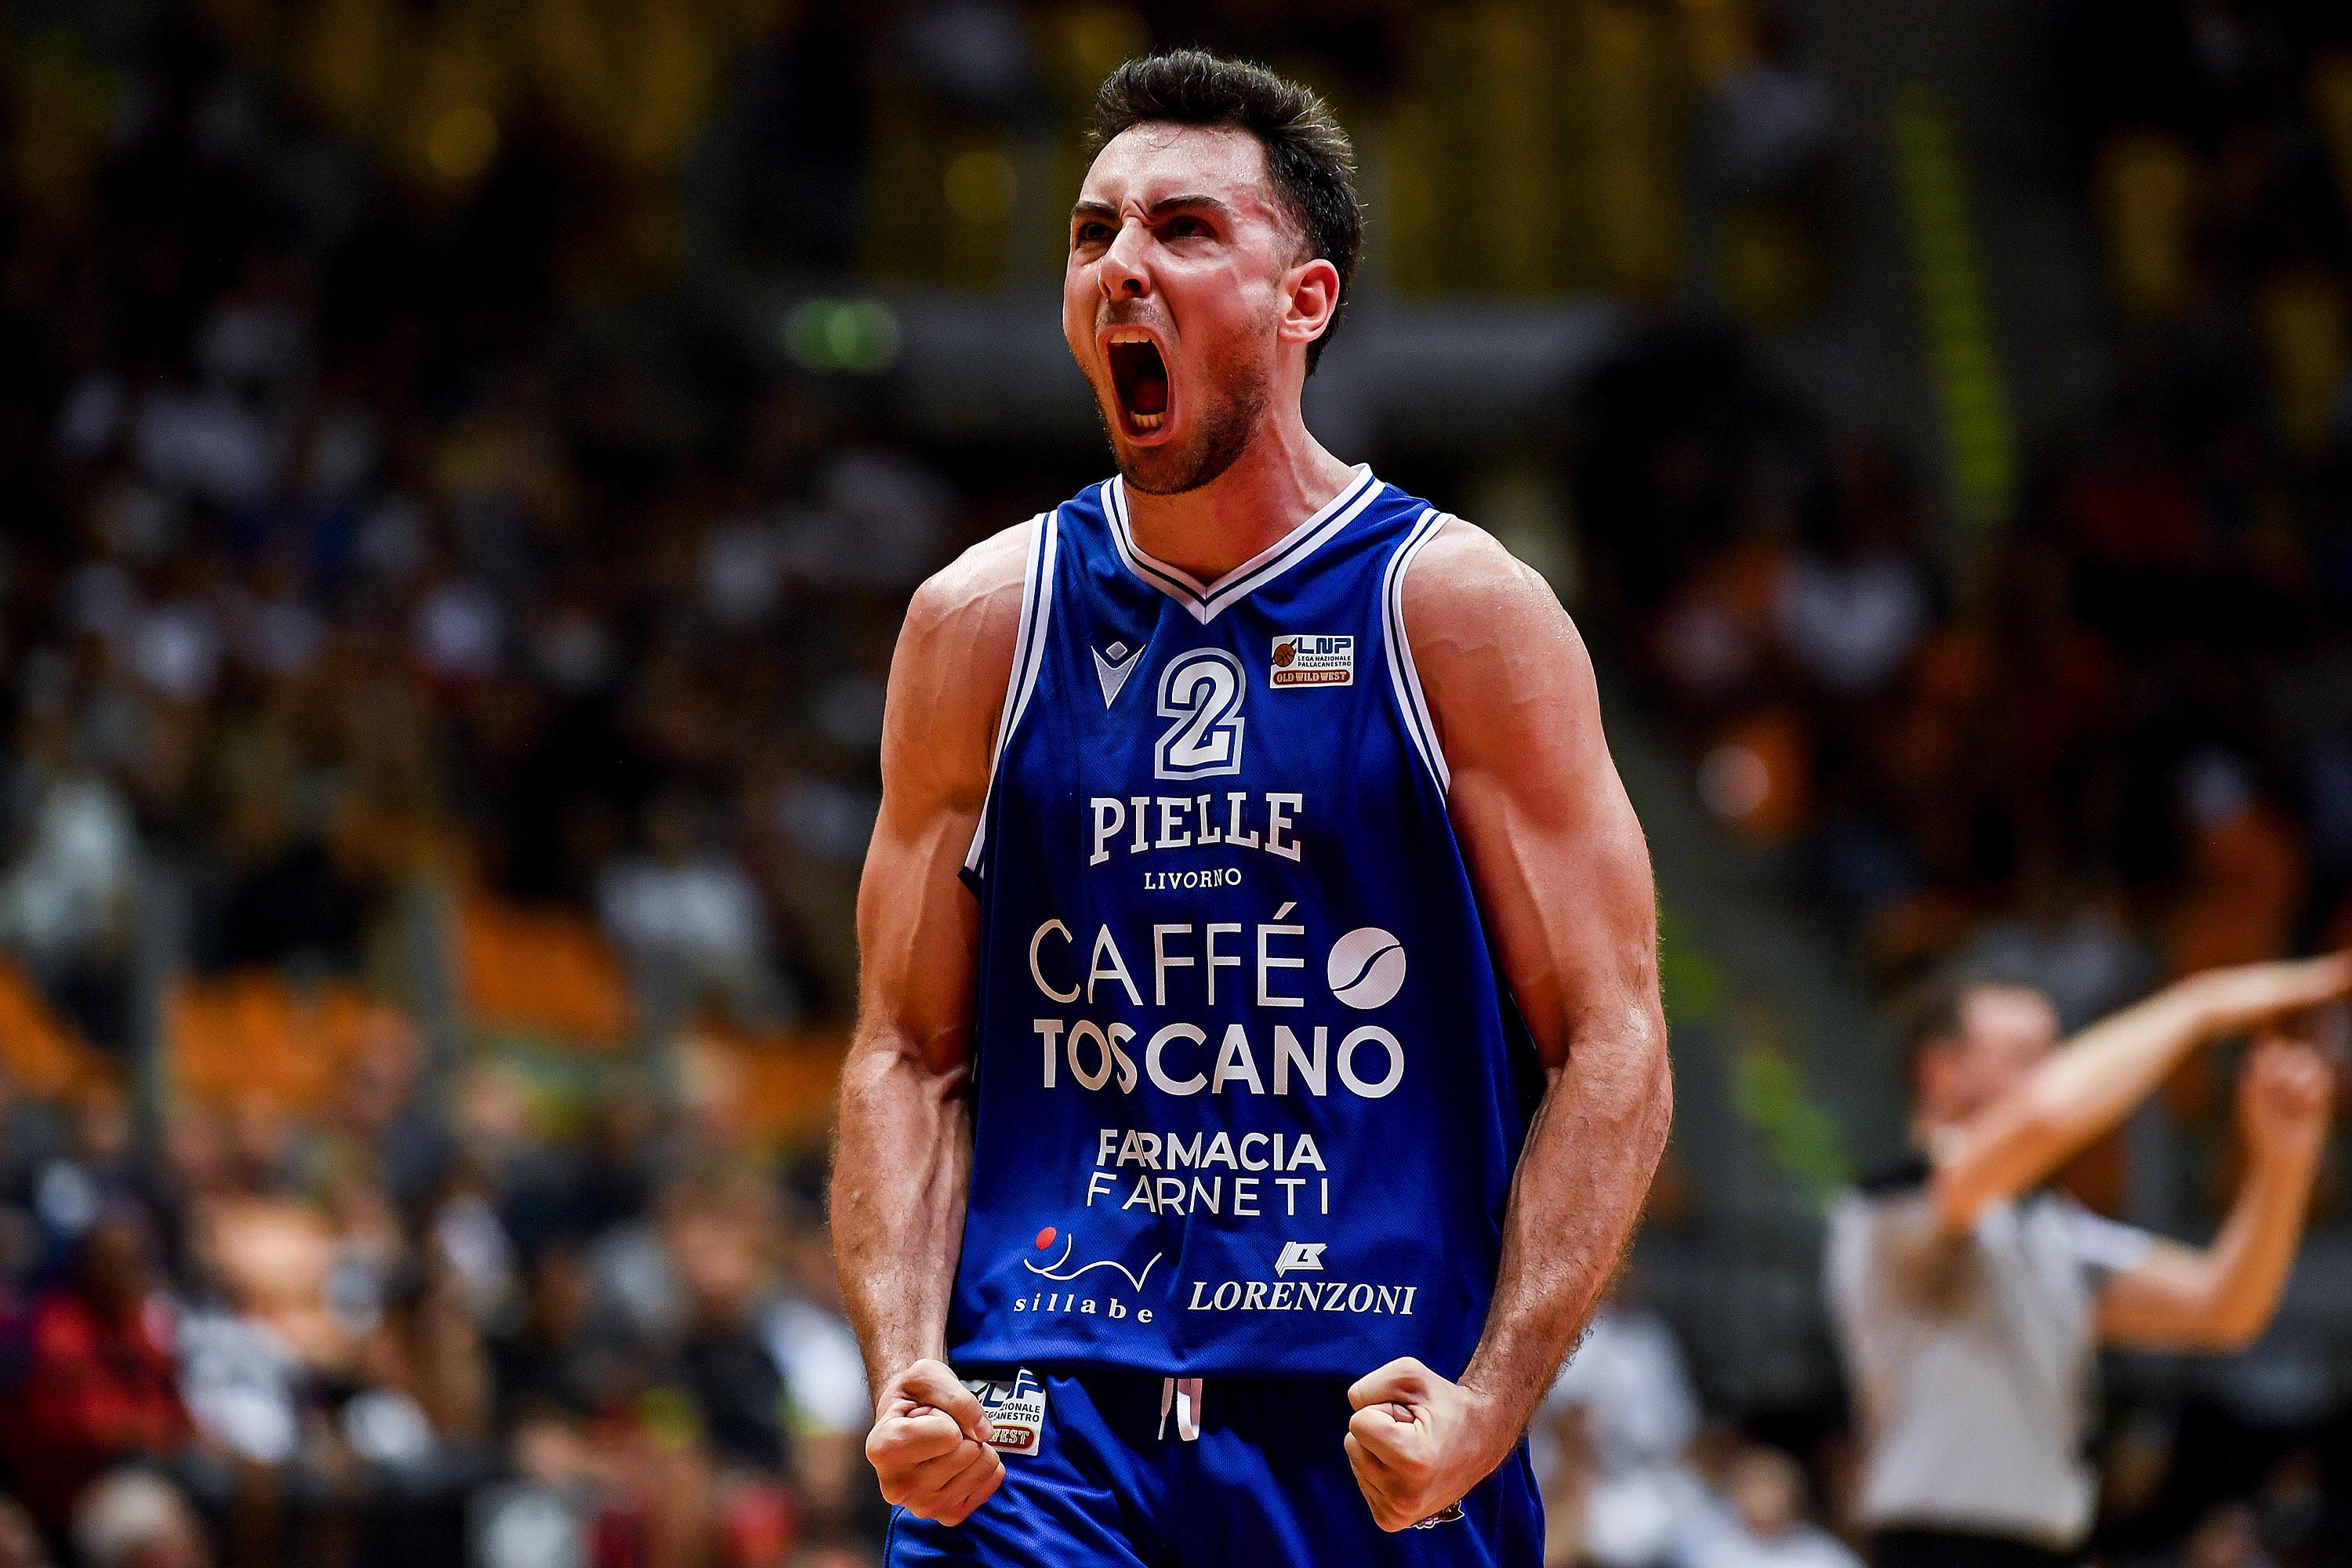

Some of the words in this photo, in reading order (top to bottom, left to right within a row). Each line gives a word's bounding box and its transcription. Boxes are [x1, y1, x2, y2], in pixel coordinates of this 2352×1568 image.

[1298, 637, 1352, 654] LNP
[1276, 673, 1294, 683] OLD
[1295, 672, 1319, 682] WILD
[1320, 671, 1347, 681] WEST
[1155, 648, 1245, 780] 2
[1090, 792, 1302, 866] PIELLE
[1145, 867, 1242, 890] LIVORNO
[1029, 902, 1305, 1007] CAFFÉ
[1034, 1019, 1404, 1098] TOSCANO
[1096, 1129, 1327, 1171] FARMACIA
[1087, 1171, 1328, 1216] FARNETI
[1014, 1293, 1153, 1323] sillabe
[1188, 1282, 1417, 1315] LORENZONI
